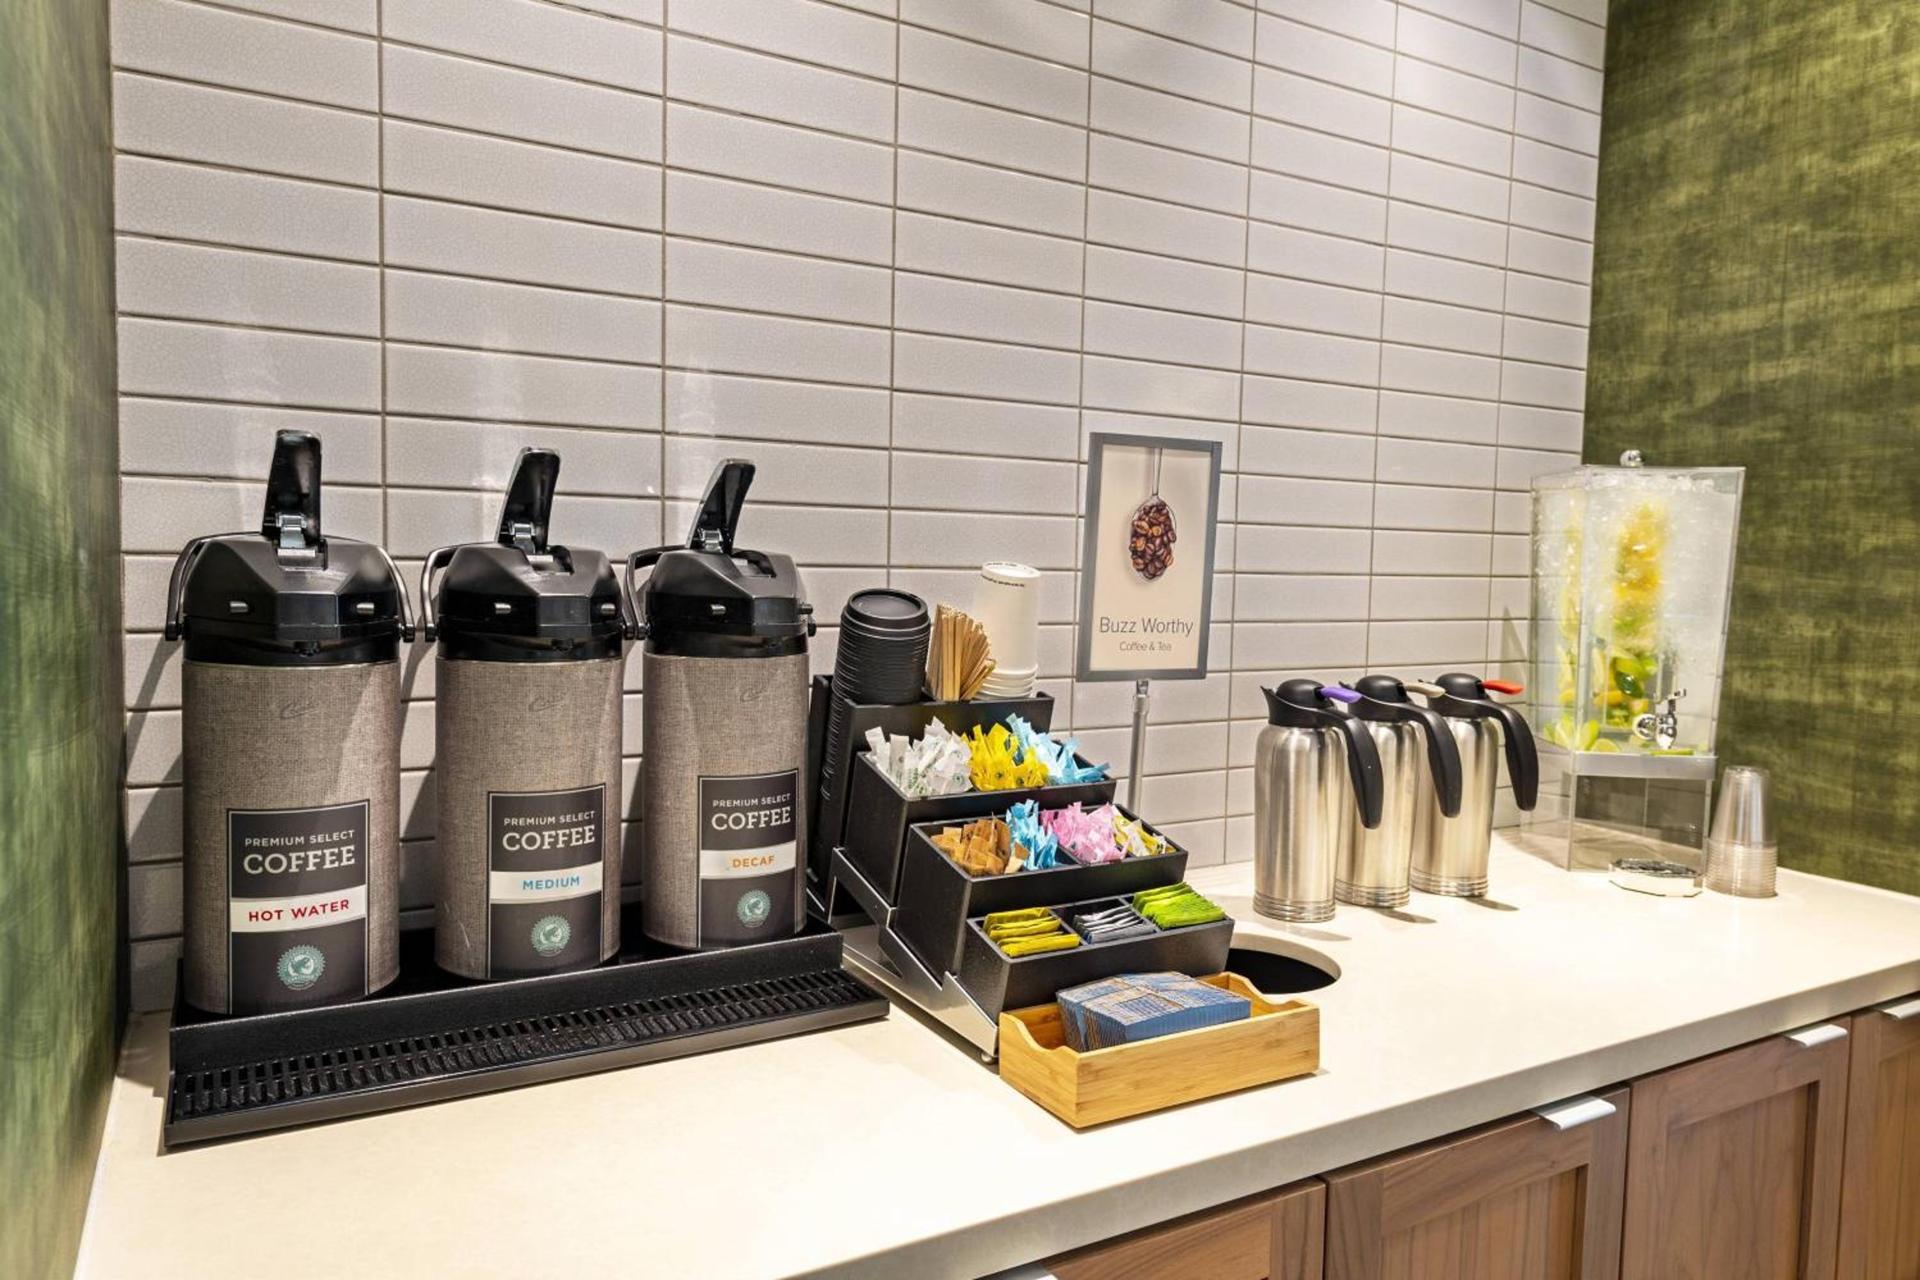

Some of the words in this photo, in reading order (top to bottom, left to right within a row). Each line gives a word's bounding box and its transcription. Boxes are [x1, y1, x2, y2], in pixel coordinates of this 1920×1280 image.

[1099, 616, 1137, 634] Buzz
[1141, 616, 1194, 638] Worthy
[1119, 641, 1147, 651] Coffee
[1149, 641, 1155, 651] &
[1158, 641, 1172, 651] Tea
[712, 798, 758, 807] PREMIUM
[760, 793, 791, 806] SELECT
[503, 816, 555, 826] PREMIUM
[559, 811, 595, 823] SELECT
[711, 806, 791, 831] COFFEE
[245, 836, 304, 847] PREMIUM
[309, 830, 355, 844] SELECT
[502, 825, 595, 851] COFFEE
[243, 845, 356, 875] COFFEE
[732, 855, 775, 869] DECAF
[522, 875, 581, 890] MEDIUM
[248, 909, 284, 923] HOT
[290, 899, 350, 920] WATER
